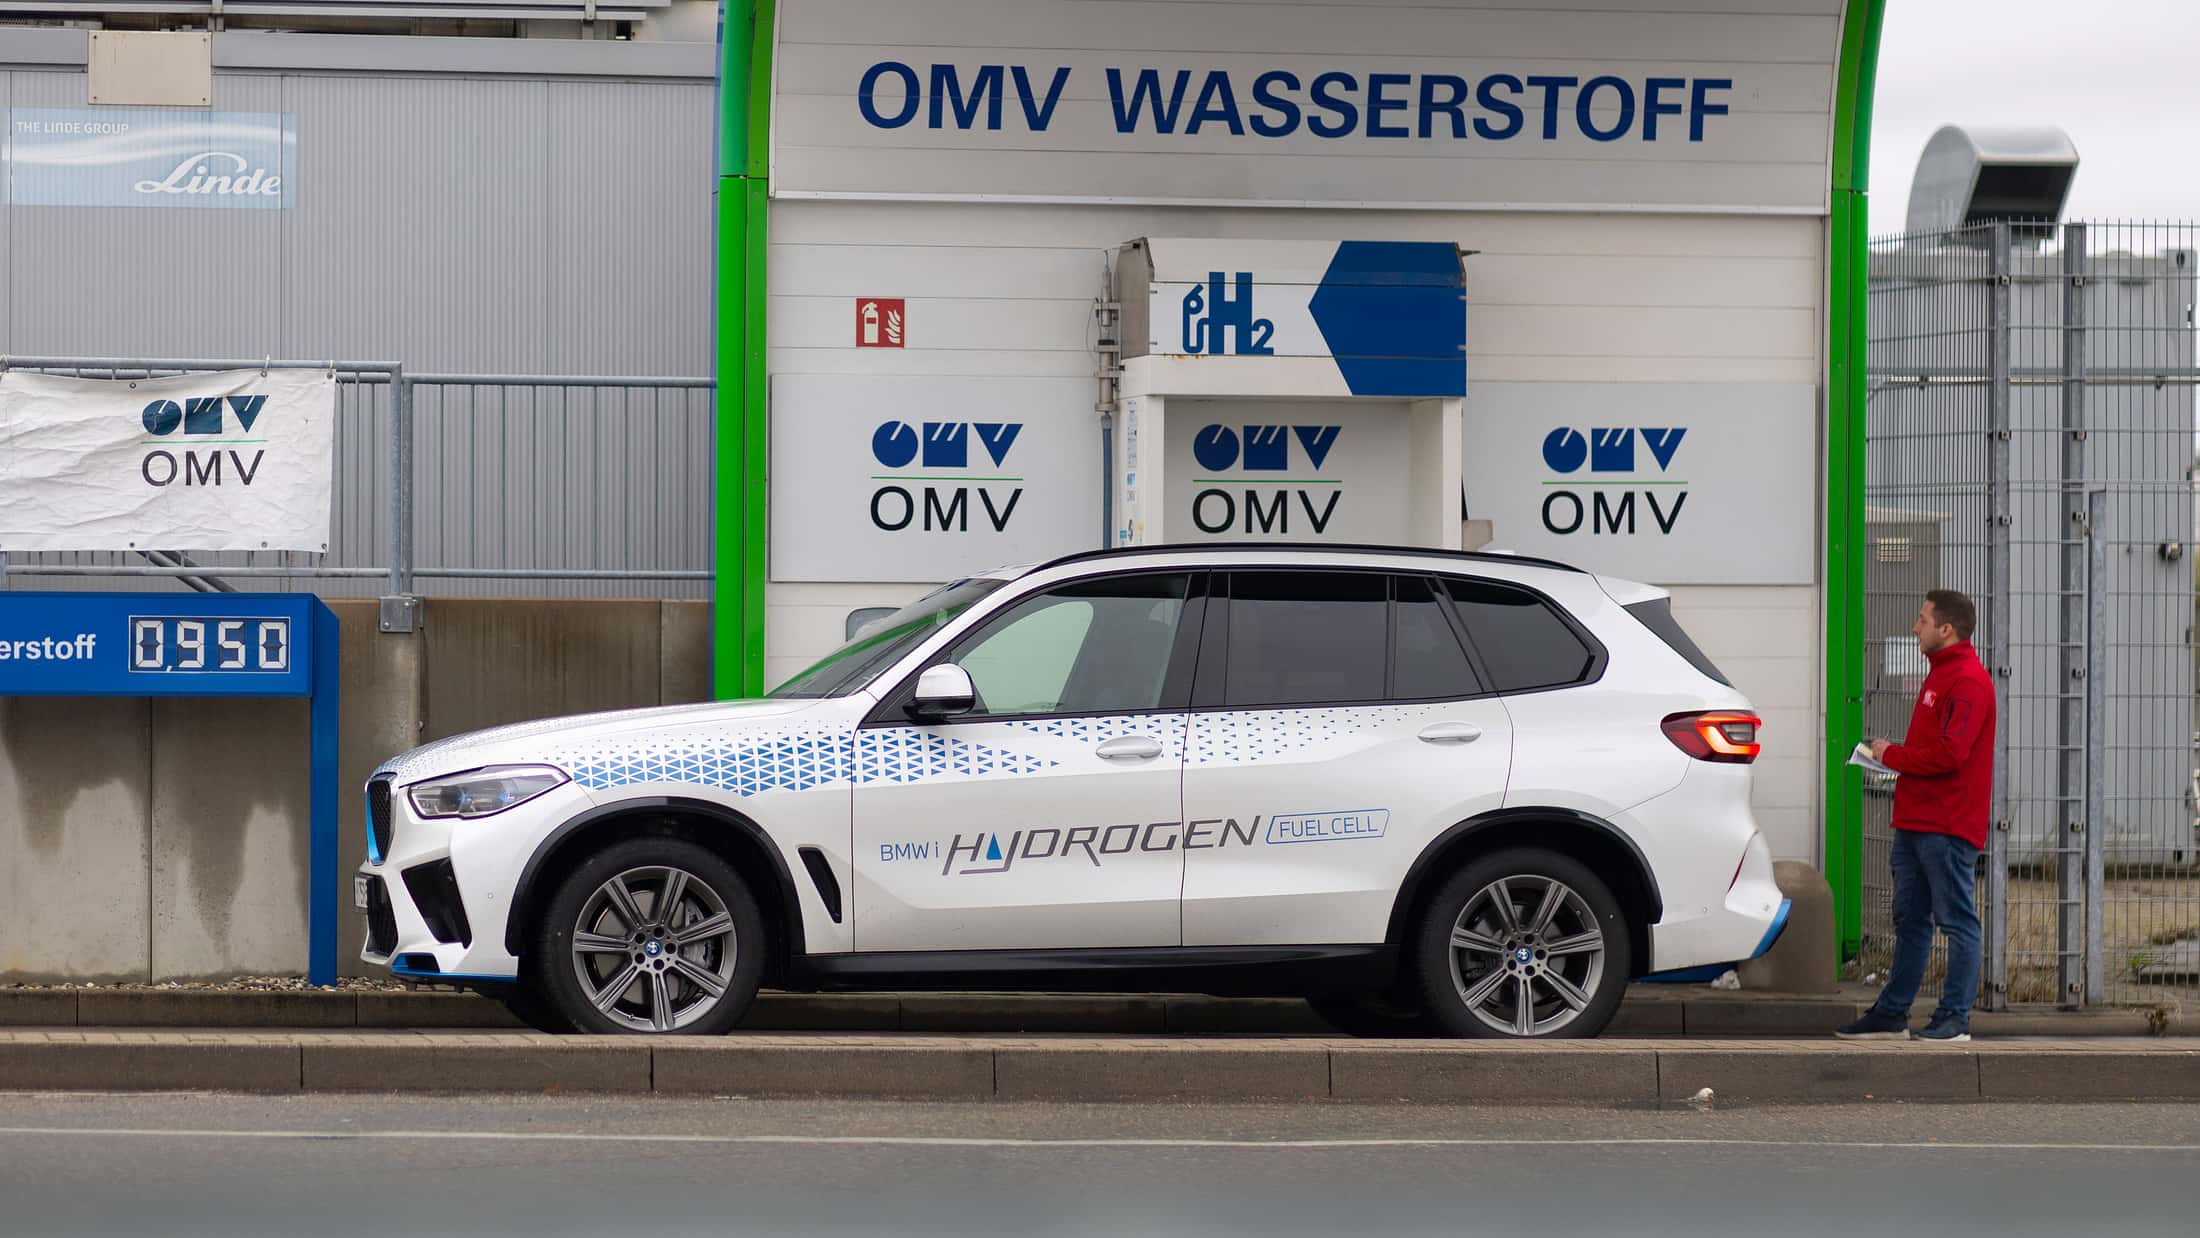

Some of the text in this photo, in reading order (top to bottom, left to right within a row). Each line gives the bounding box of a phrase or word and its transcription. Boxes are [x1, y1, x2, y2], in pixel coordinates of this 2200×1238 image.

[859, 63, 1732, 142] OMV WASSERSTOFF
[16, 121, 41, 133] THE
[84, 122, 129, 136] GROUP
[134, 152, 282, 195] Linde
[142, 449, 265, 487] OMV
[870, 486, 1023, 532] OMV
[1192, 488, 1342, 534] OMV
[1541, 490, 1688, 535] OMV
[135, 620, 287, 673] 0,950
[880, 815, 1379, 876] BMW i HYDROGEN FUEL CELL
